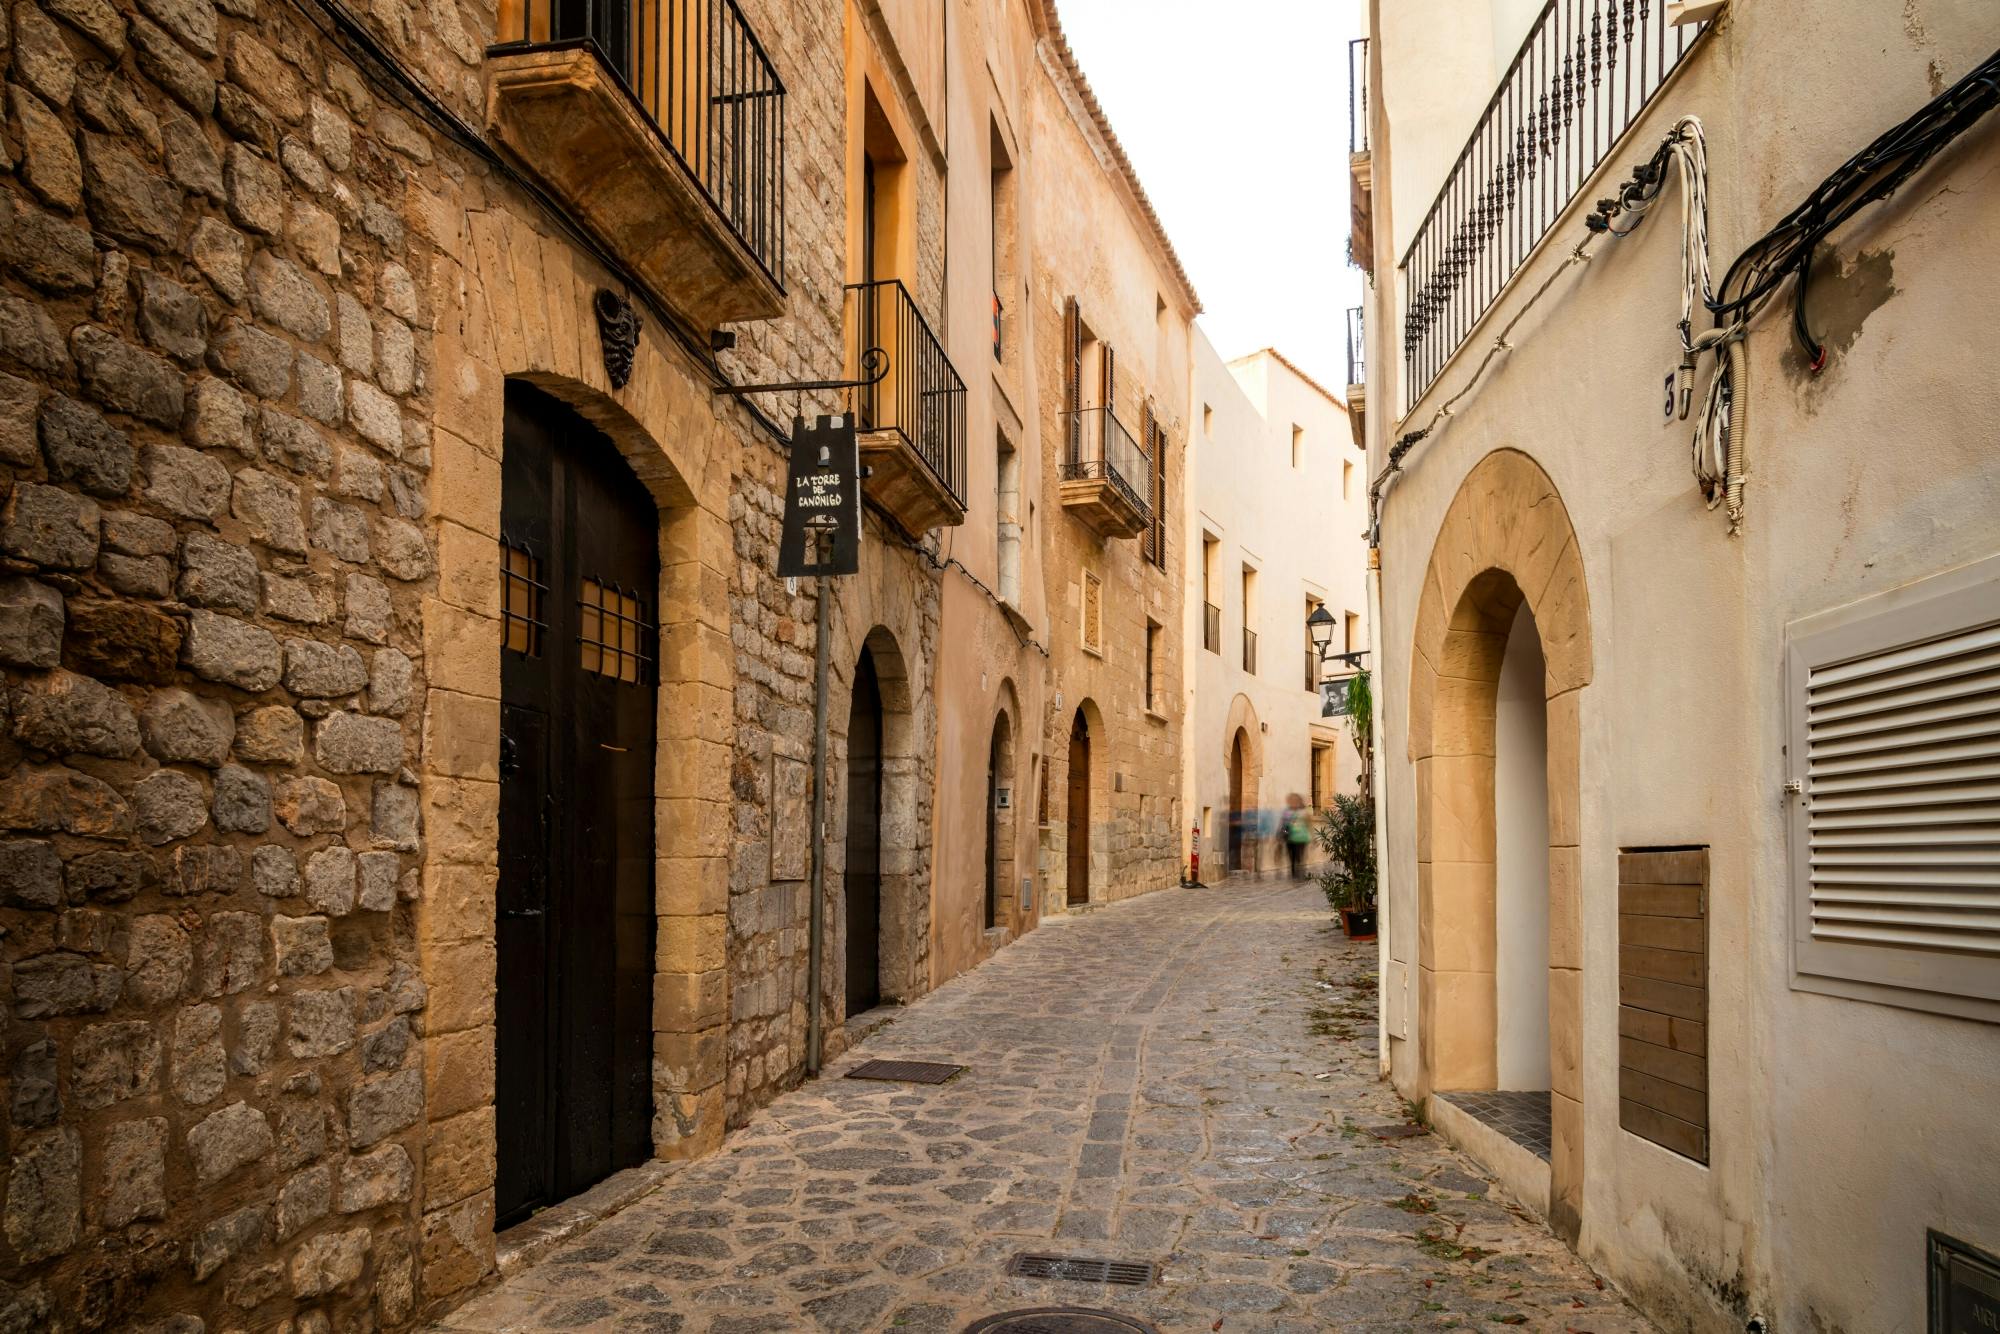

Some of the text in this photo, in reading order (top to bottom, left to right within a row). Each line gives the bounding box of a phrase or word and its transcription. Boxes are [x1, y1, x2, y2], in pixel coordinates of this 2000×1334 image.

[1665, 371, 1675, 417] 3
[796, 473, 840, 488] LA TORRE
[812, 485, 826, 494] DEL
